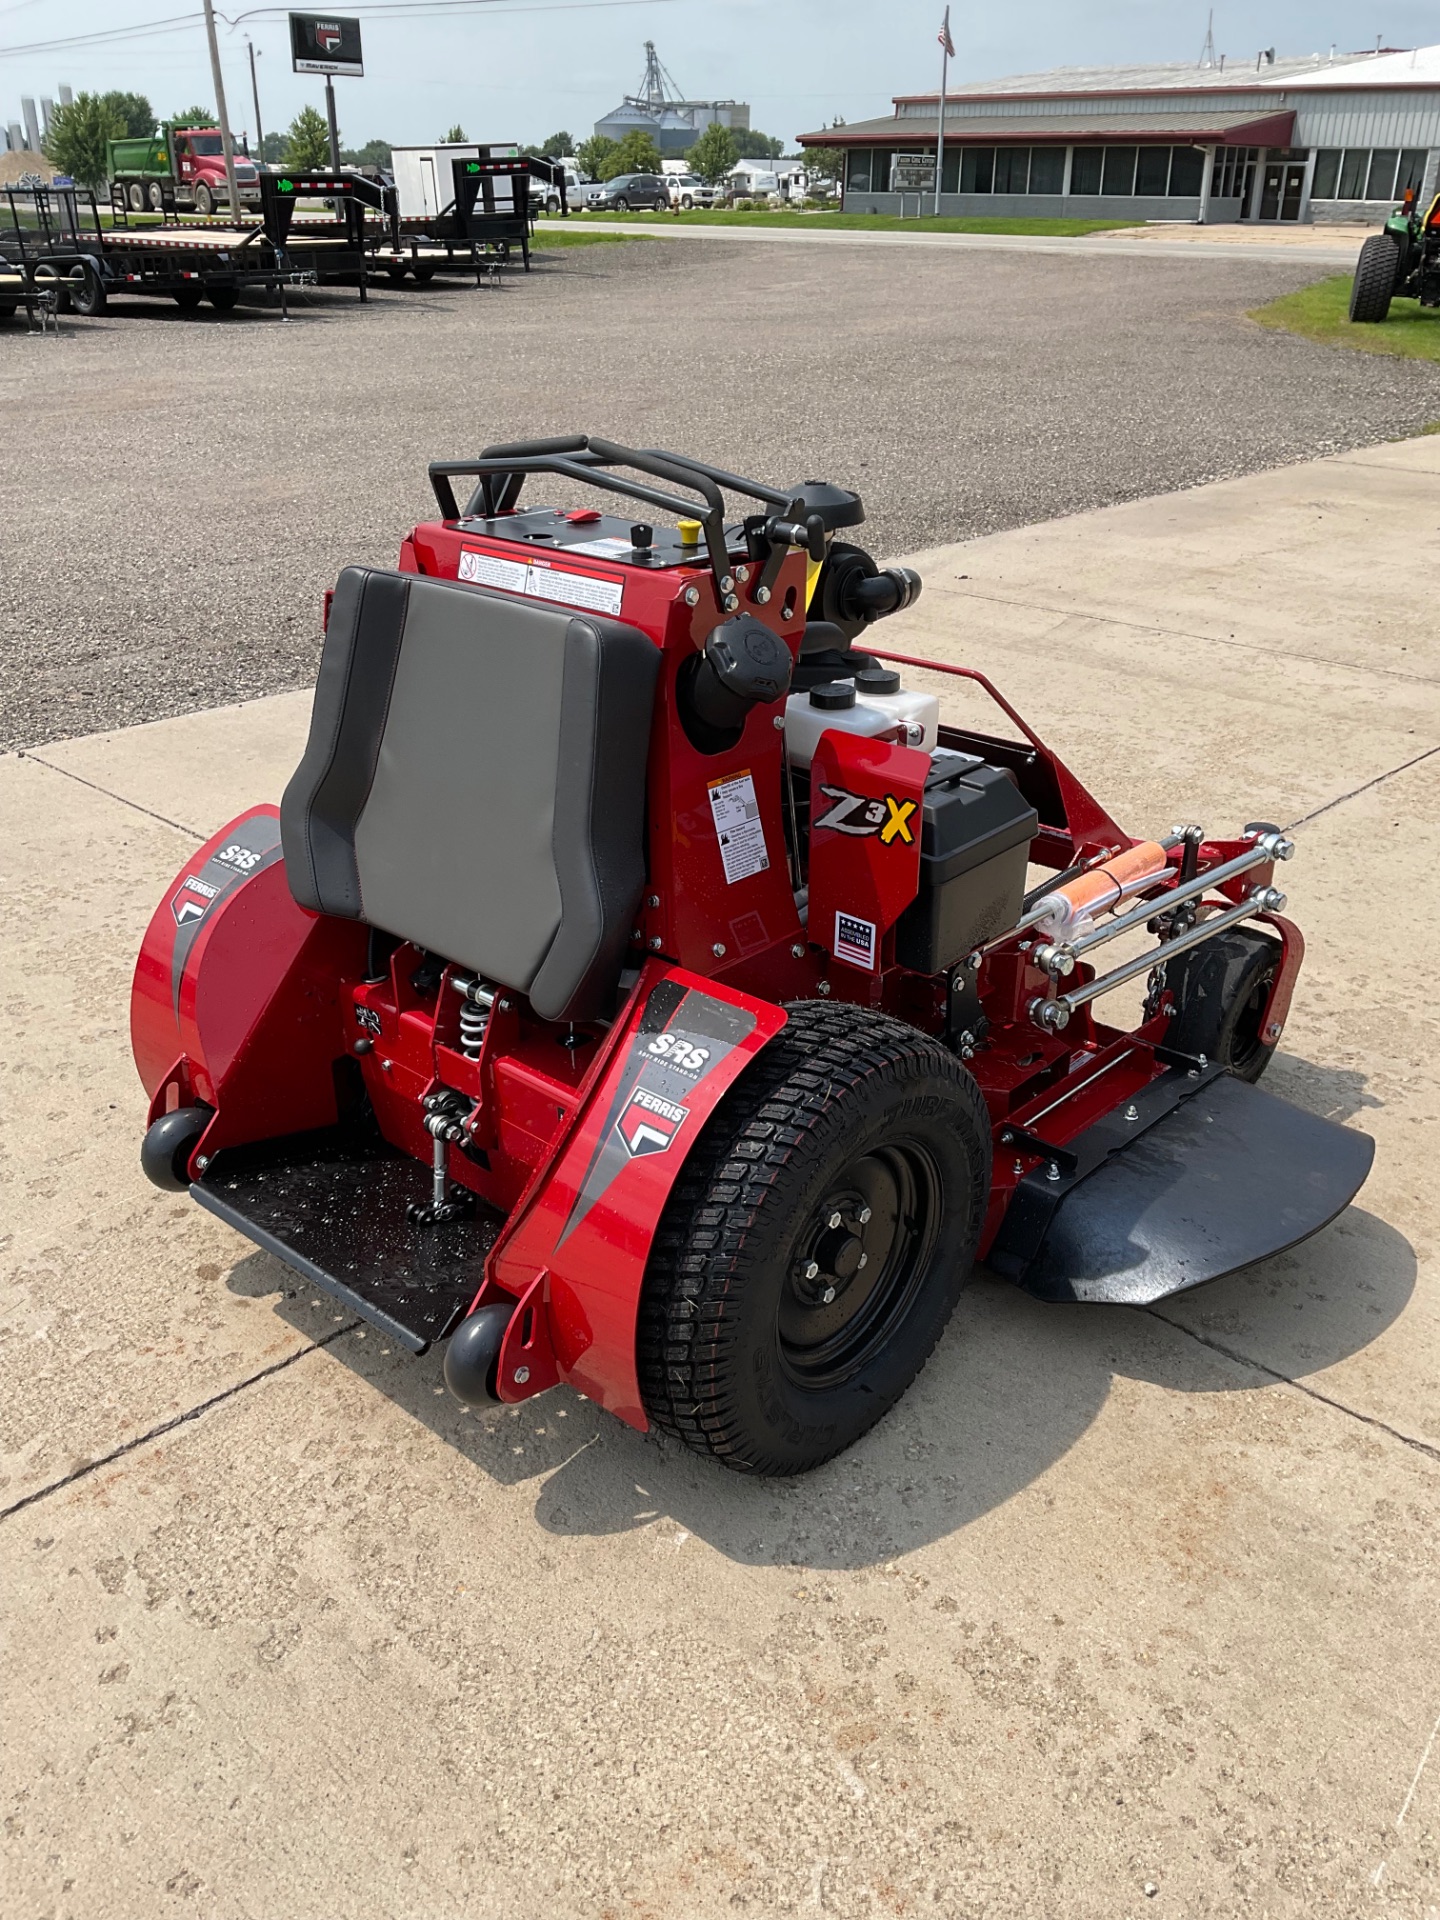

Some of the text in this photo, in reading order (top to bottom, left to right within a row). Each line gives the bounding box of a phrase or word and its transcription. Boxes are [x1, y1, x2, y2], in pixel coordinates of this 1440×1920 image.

[316, 23, 340, 31] FERRIS
[305, 62, 338, 70] MAVERICK
[533, 559, 551, 568] DANGER
[814, 785, 917, 844] Z3X
[220, 845, 262, 869] SRS
[184, 878, 217, 899] FERRIS
[855, 938, 869, 947] USA
[649, 1033, 710, 1069] SRS
[638, 1050, 698, 1080] SOFT RIDE STAND-ON
[633, 1092, 686, 1122] FERRIS
[879, 1095, 955, 1135] TURF
